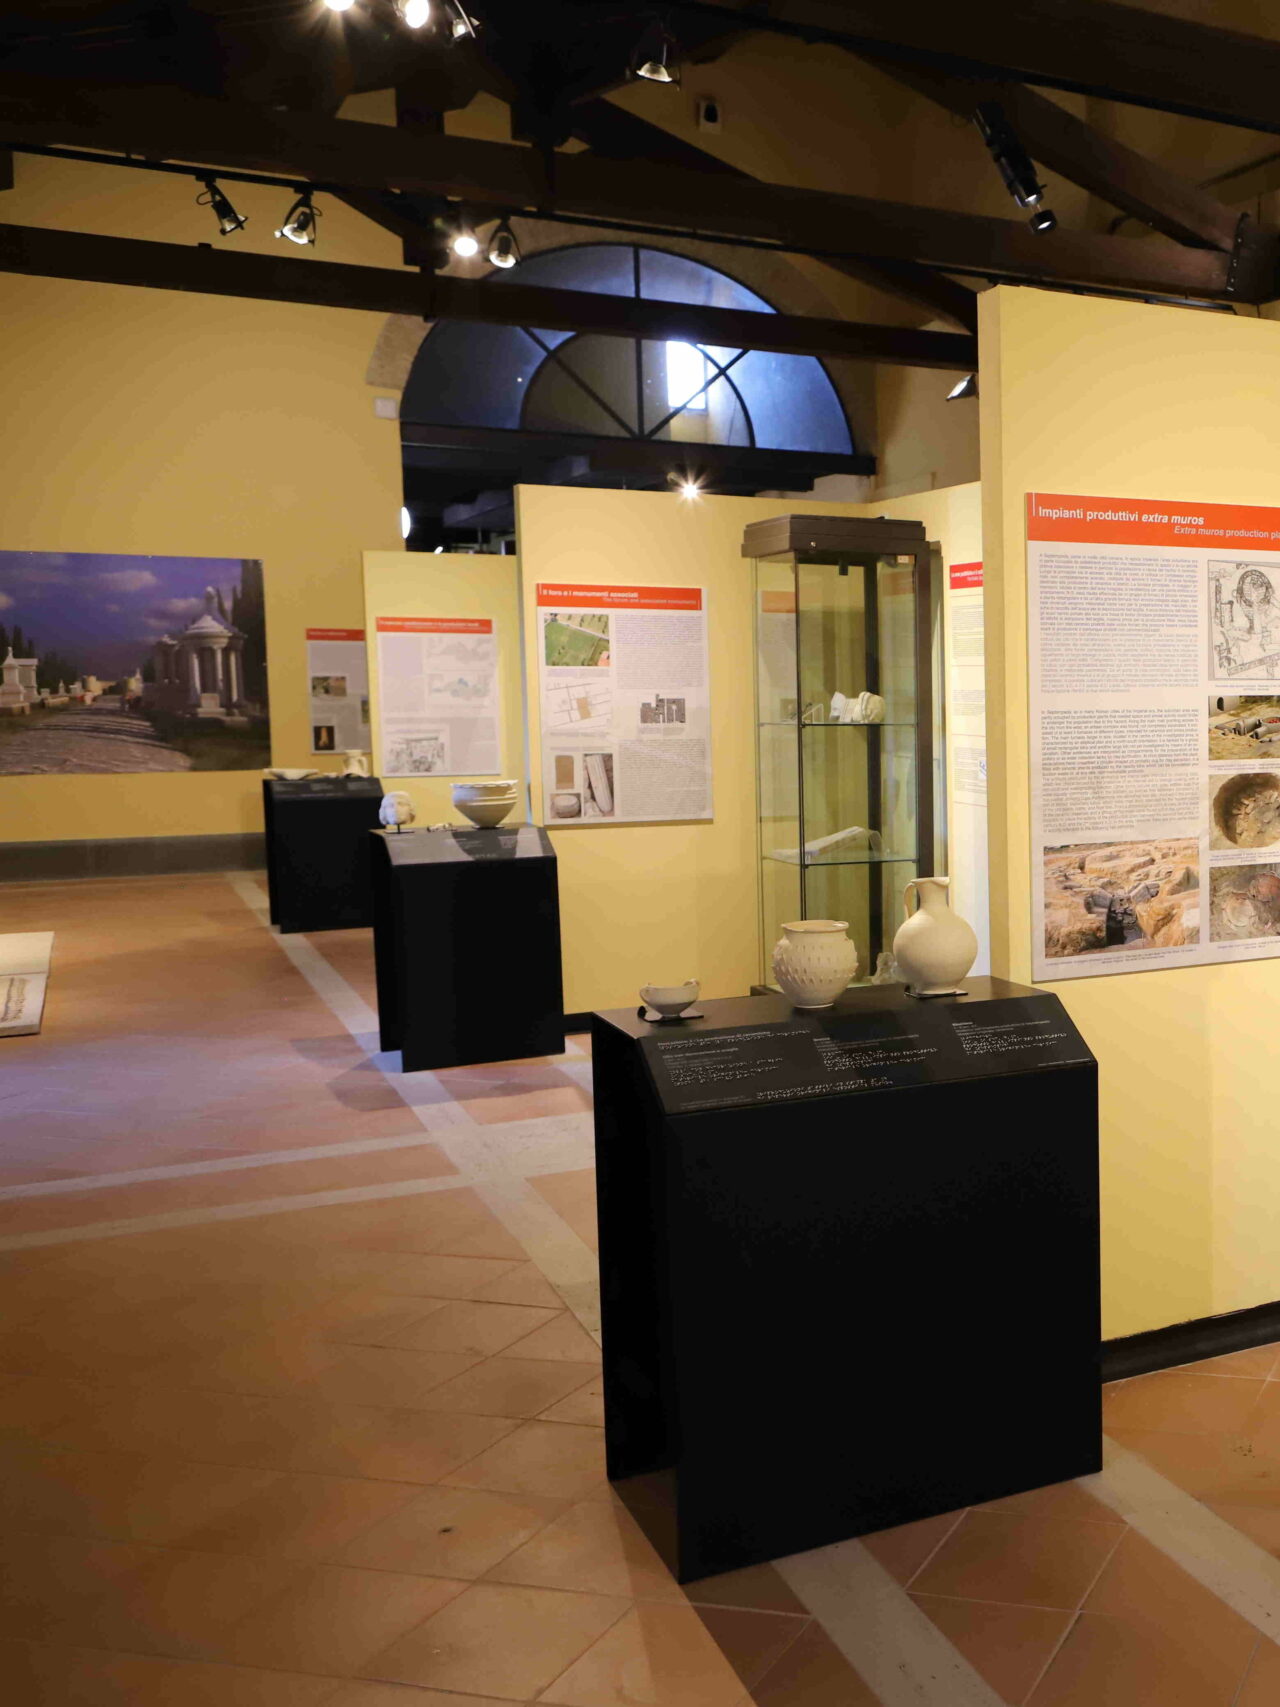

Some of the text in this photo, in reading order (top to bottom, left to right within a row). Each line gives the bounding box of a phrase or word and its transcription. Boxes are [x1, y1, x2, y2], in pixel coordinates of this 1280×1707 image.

[1038, 506, 1205, 525] Impianti produttivi extra muros
[1174, 525, 1196, 535] Extra
[1198, 527, 1224, 536] muros
[1225, 528, 1269, 539] production
